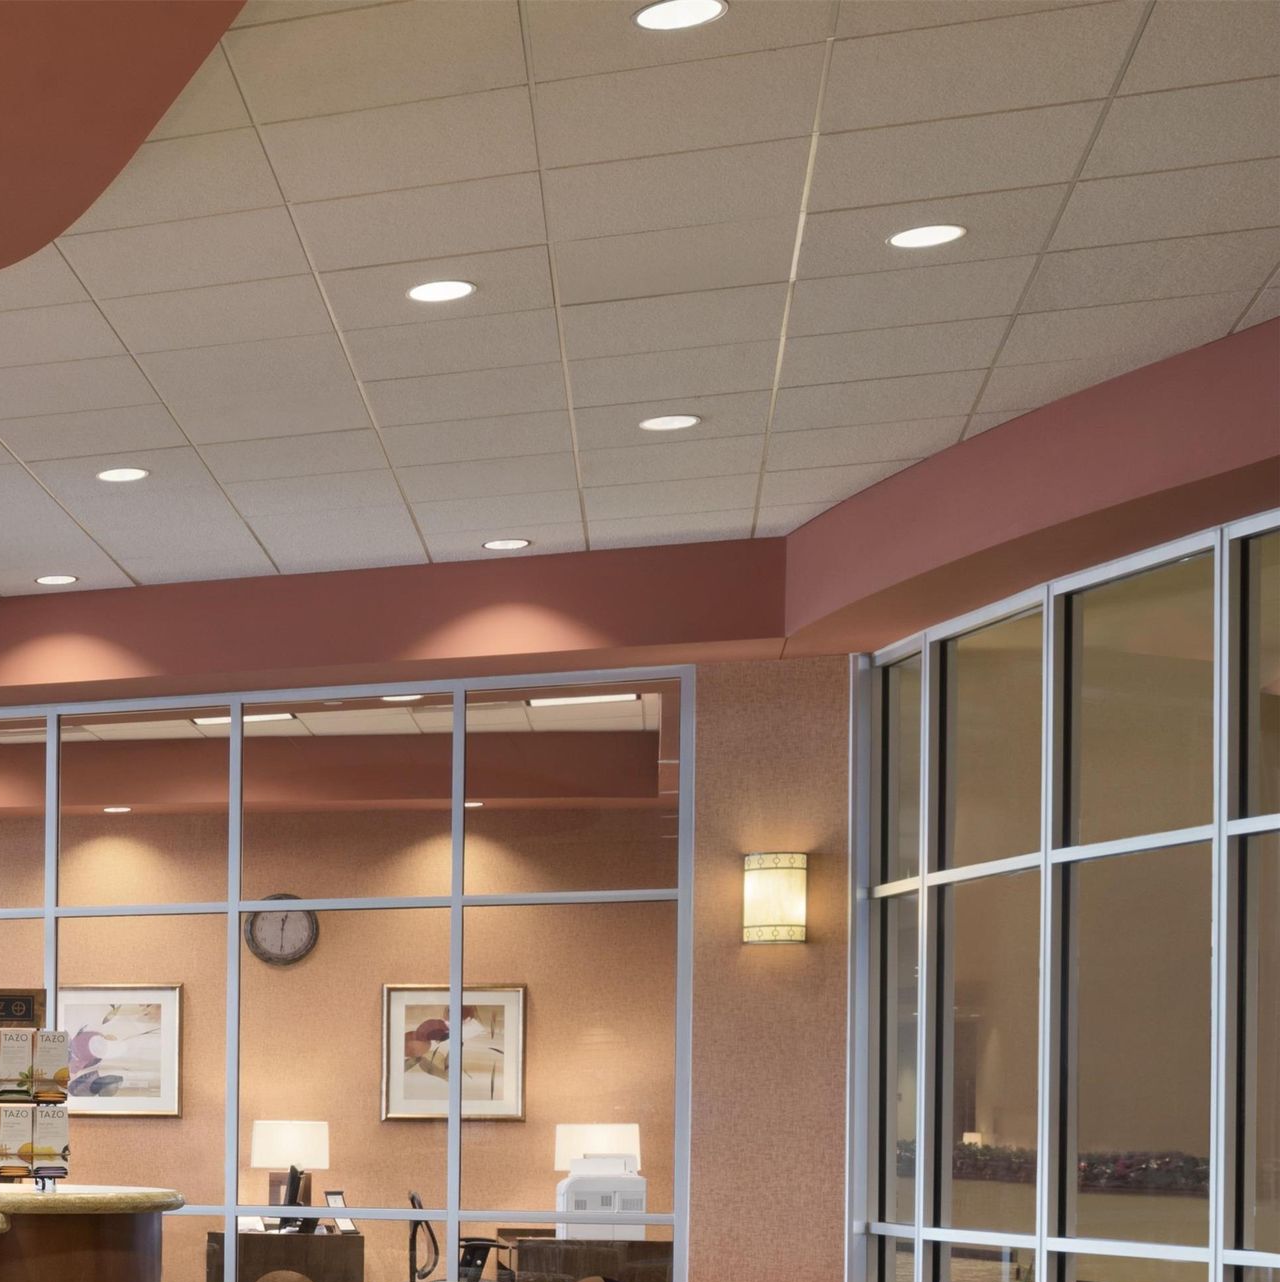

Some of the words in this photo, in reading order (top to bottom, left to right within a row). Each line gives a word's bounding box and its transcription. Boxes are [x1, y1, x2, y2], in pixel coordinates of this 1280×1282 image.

[3, 1033, 29, 1042] TAZO
[40, 1034, 65, 1044] TAZO
[3, 1109, 29, 1118] TAZO
[40, 1110, 65, 1119] TAZO
